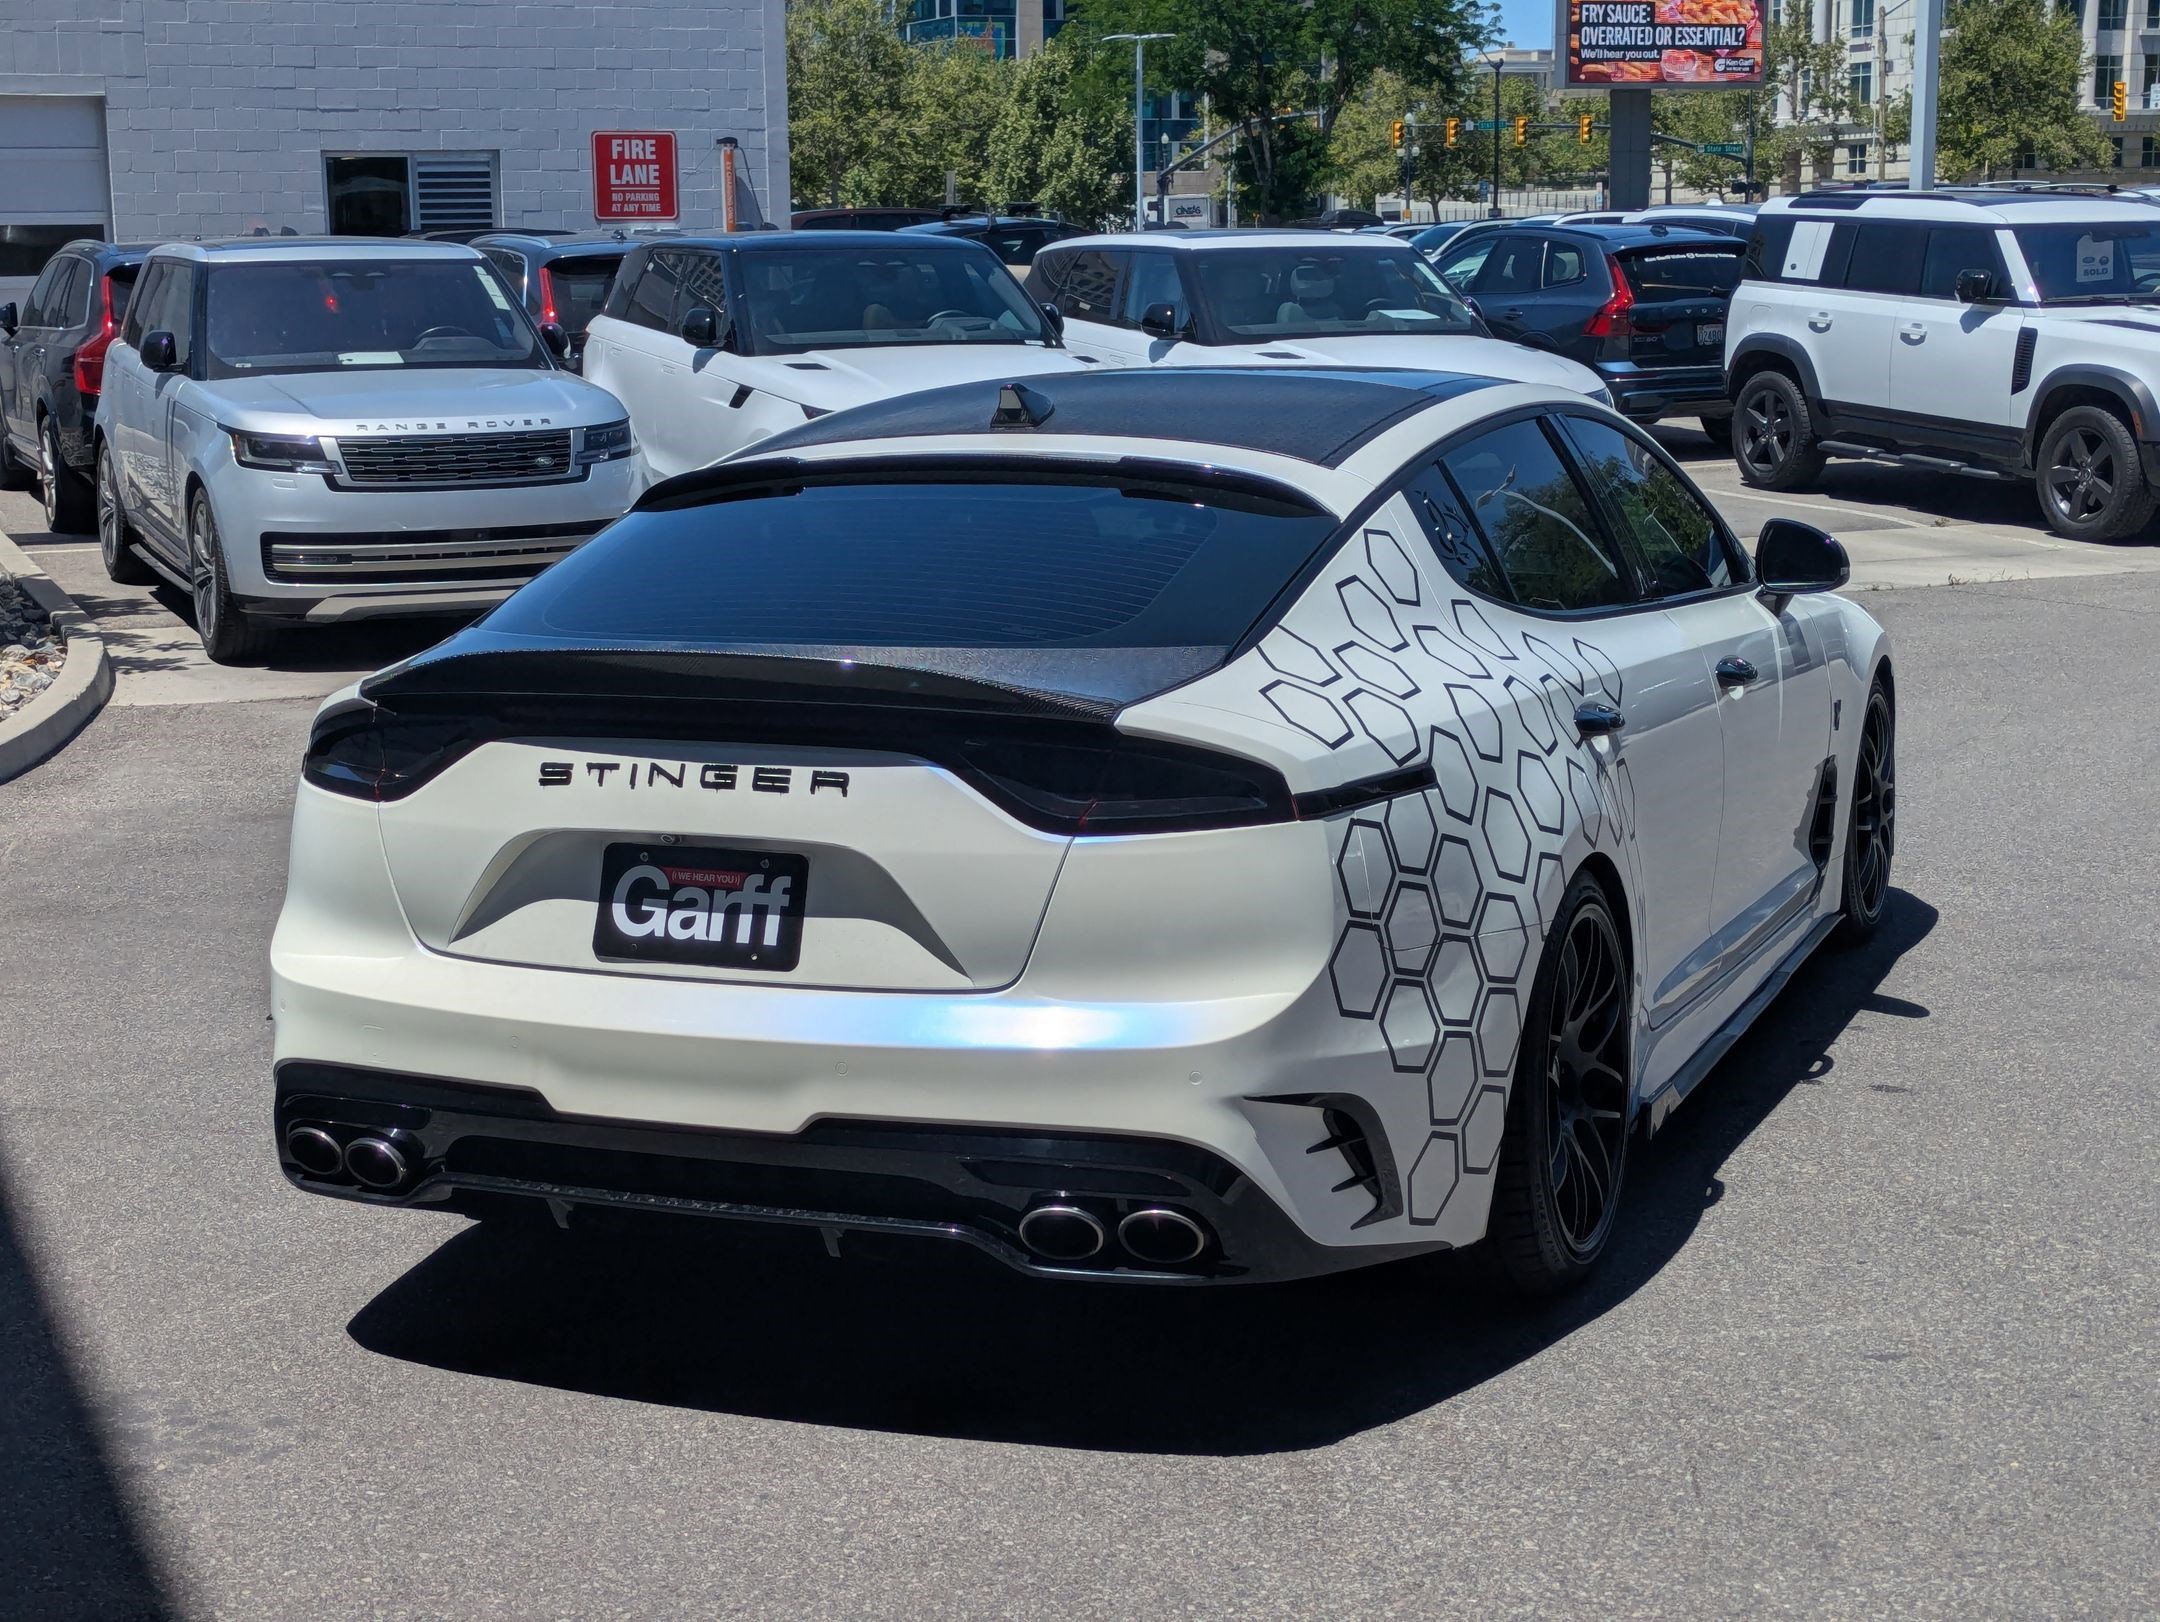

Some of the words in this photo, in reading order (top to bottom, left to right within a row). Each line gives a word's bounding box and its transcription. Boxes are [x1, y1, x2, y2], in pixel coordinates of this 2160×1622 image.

[1581, 4, 1607, 23] FRY
[1607, 4, 1651, 23] SAUCE:
[1581, 26, 1653, 46] OVERRATED
[1655, 27, 1672, 45] OR
[1675, 27, 1745, 46] ESSENTIAL?
[1581, 49, 1603, 59] We'll
[1604, 49, 1624, 59] hear
[1625, 51, 1643, 61] you
[1643, 50, 1660, 59] out.
[611, 139, 657, 160] FIRE
[609, 164, 660, 185] LANE
[611, 192, 624, 202] NO
[625, 192, 660, 202] PARKING
[611, 203, 622, 212] AT
[623, 203, 639, 212] ANY
[641, 203, 661, 212] TIME
[2083, 267, 2109, 277] SOLD
[355, 422, 448, 432] RANGE
[467, 417, 552, 430] ROVER
[537, 761, 851, 799] STINGER
[677, 871, 691, 881] WE
[692, 872, 715, 883] HEAR
[717, 874, 734, 884] YOU
[611, 864, 792, 947] Garff
